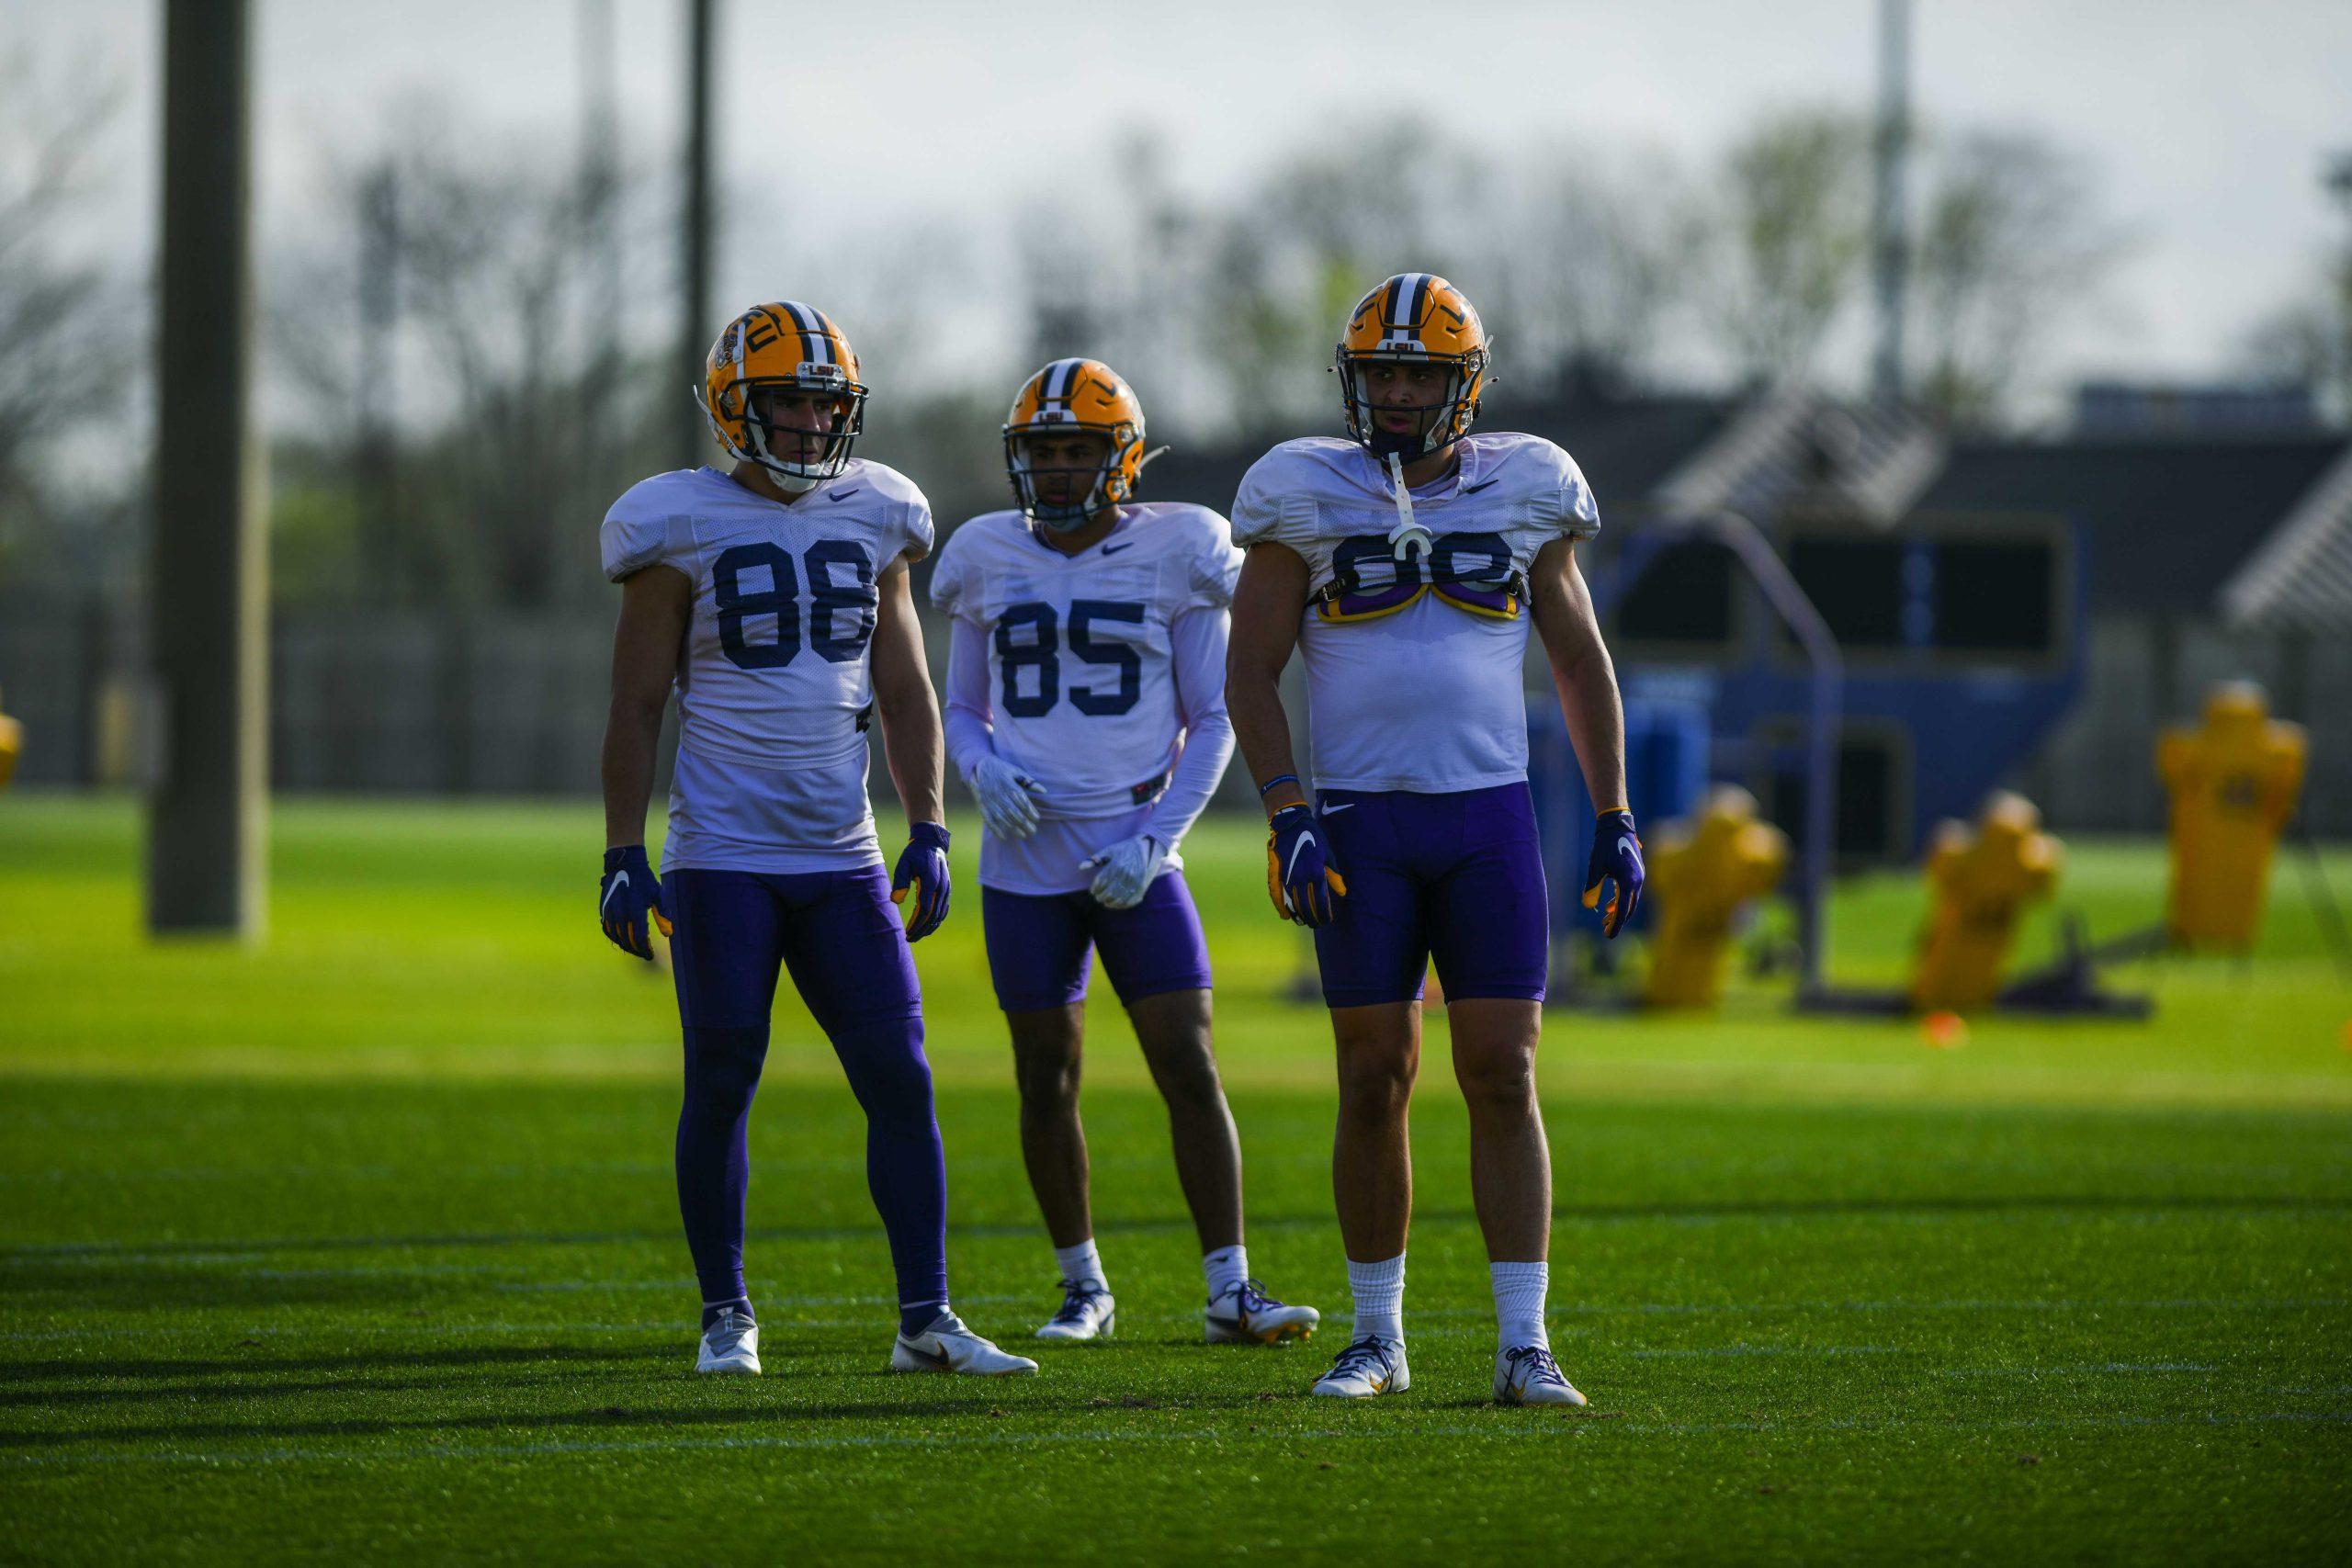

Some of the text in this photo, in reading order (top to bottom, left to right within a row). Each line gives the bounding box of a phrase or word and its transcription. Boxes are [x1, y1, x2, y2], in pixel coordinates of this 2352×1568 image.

[808, 365, 834, 377] LSU
[712, 539, 879, 669] 88
[995, 599, 1146, 717] 85
